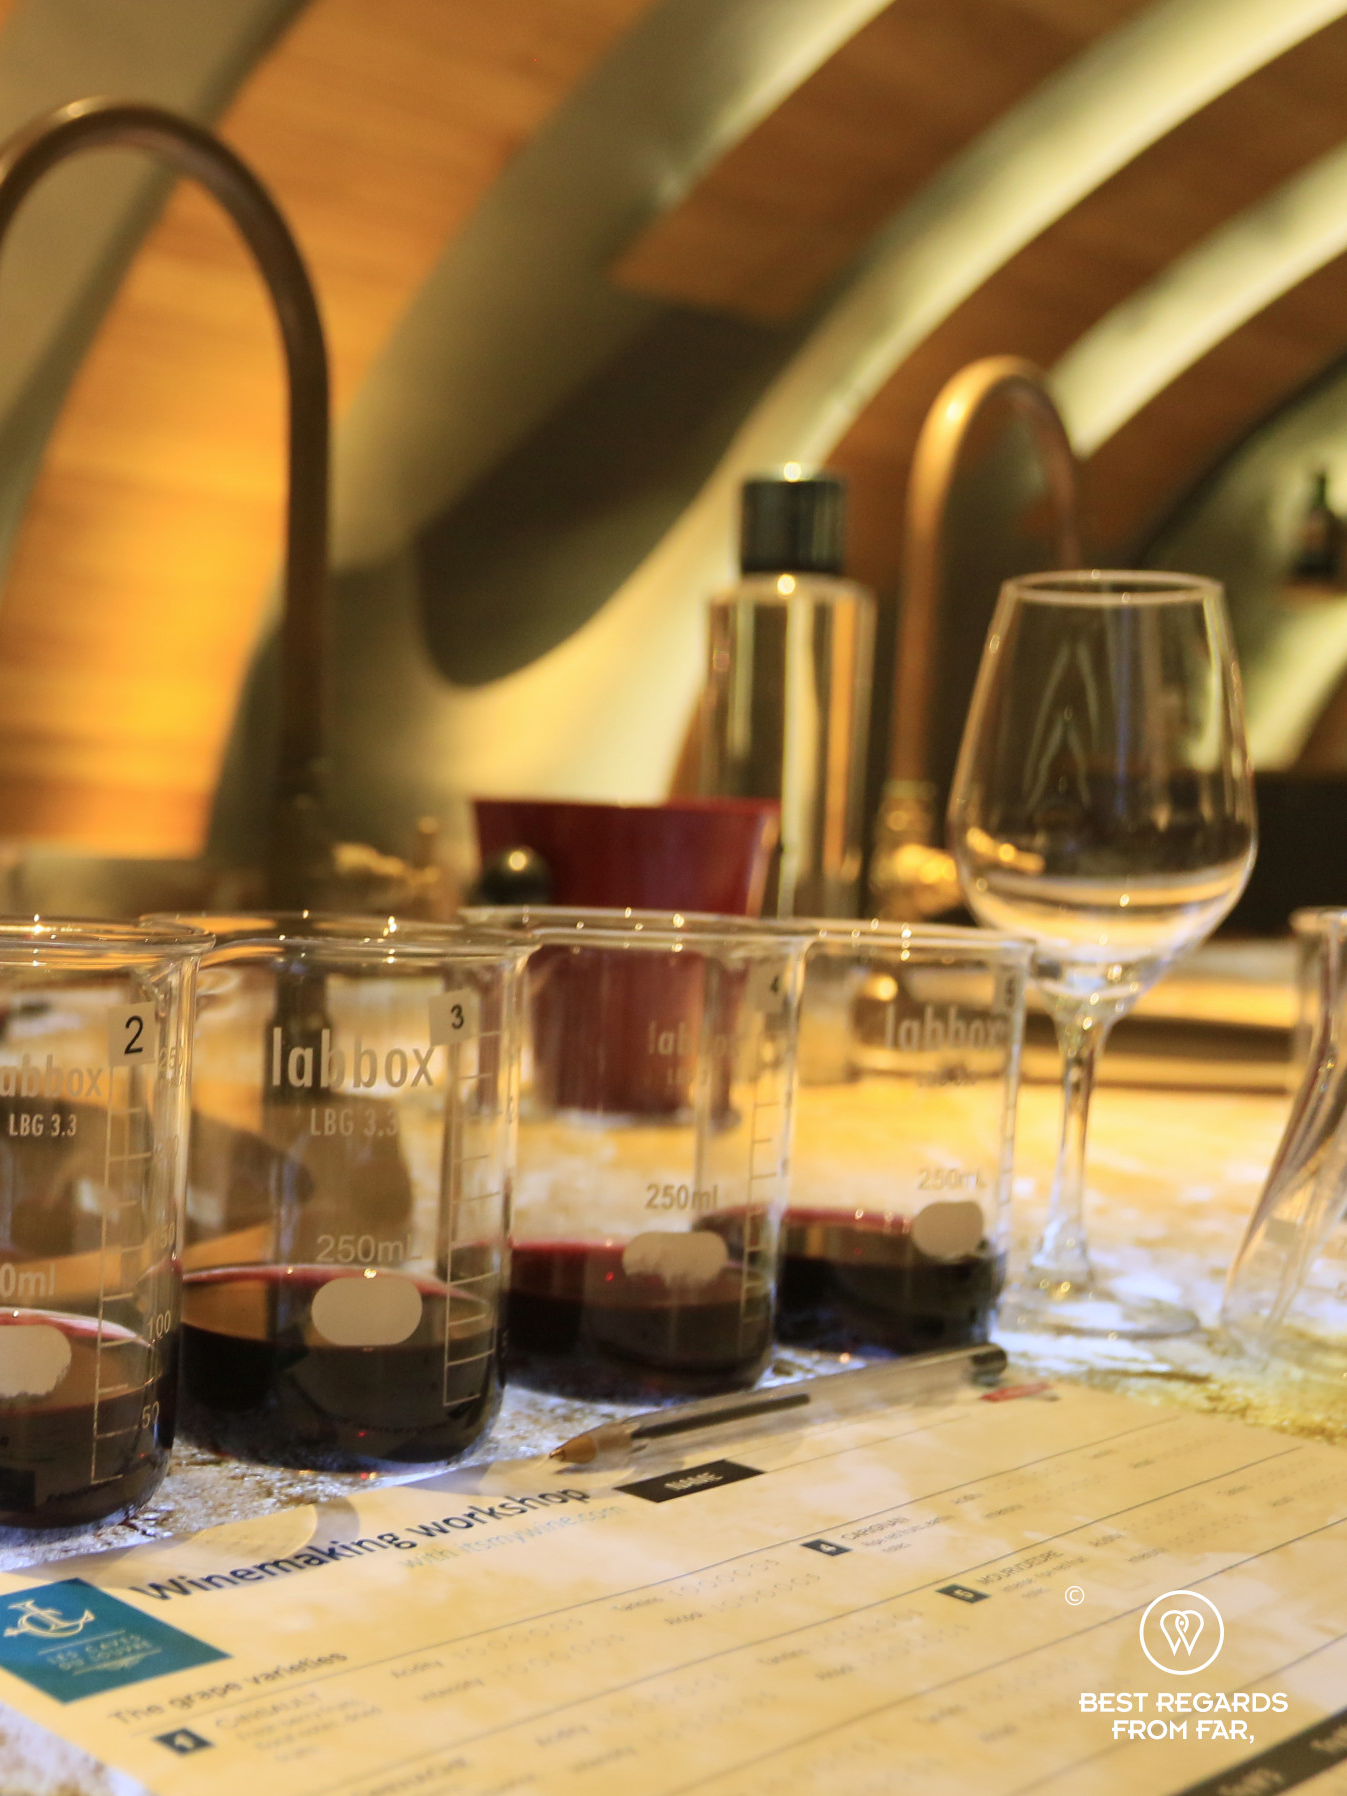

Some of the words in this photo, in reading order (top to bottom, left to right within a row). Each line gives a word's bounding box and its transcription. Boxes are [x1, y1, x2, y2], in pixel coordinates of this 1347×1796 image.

[450, 1003, 465, 1030] 3
[124, 1014, 144, 1056] 2
[272, 1026, 436, 1089] labbox
[8, 1113, 45, 1138] LBG
[50, 1113, 77, 1138] 3.3
[309, 1107, 353, 1137] LBG
[363, 1108, 398, 1137] 3.3
[645, 1183, 719, 1211] 250ml
[146, 1310, 172, 1340] 100
[141, 1400, 161, 1430] 50
[128, 1529, 418, 1601] Winemaking
[405, 1488, 592, 1539] workshop
